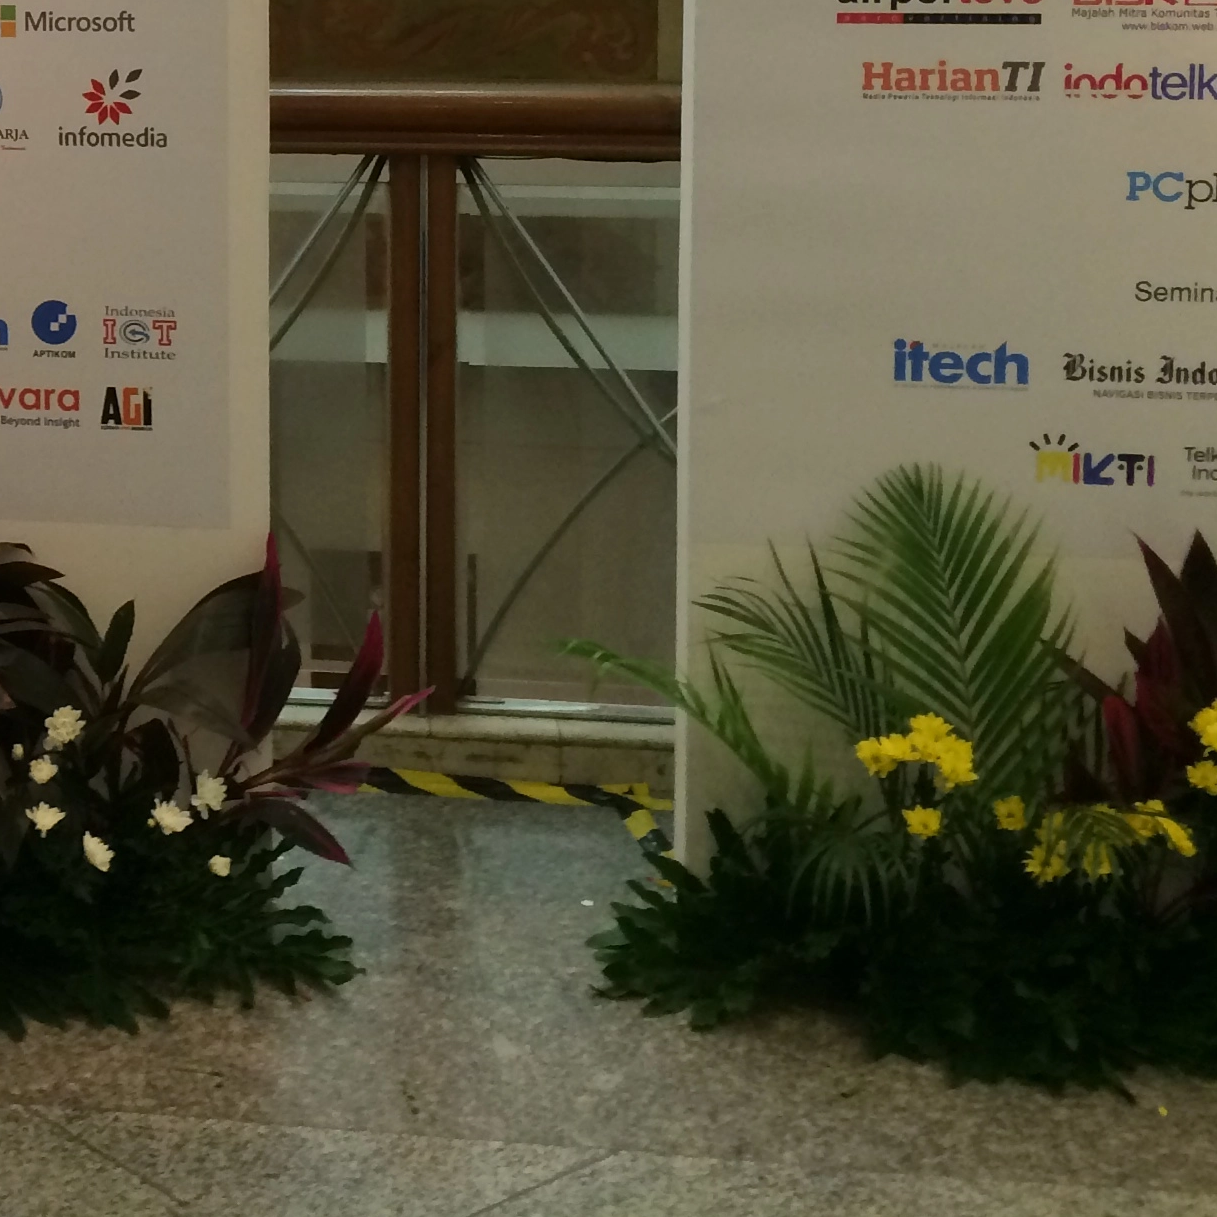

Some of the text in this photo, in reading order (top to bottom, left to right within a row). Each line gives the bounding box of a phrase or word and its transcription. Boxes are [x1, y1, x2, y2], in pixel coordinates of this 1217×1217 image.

[24, 9, 136, 33] Microsoft
[57, 125, 168, 149] infomedia
[1134, 279, 1217, 303] Semin
[104, 305, 176, 319] Indonesia
[32, 349, 77, 359] APTIKOM
[104, 347, 177, 361] Institute
[893, 338, 1030, 385] itech
[1062, 351, 1146, 384] Bisnis
[101, 386, 153, 426] AGI
[0, 415, 80, 430] Beyond Insight
